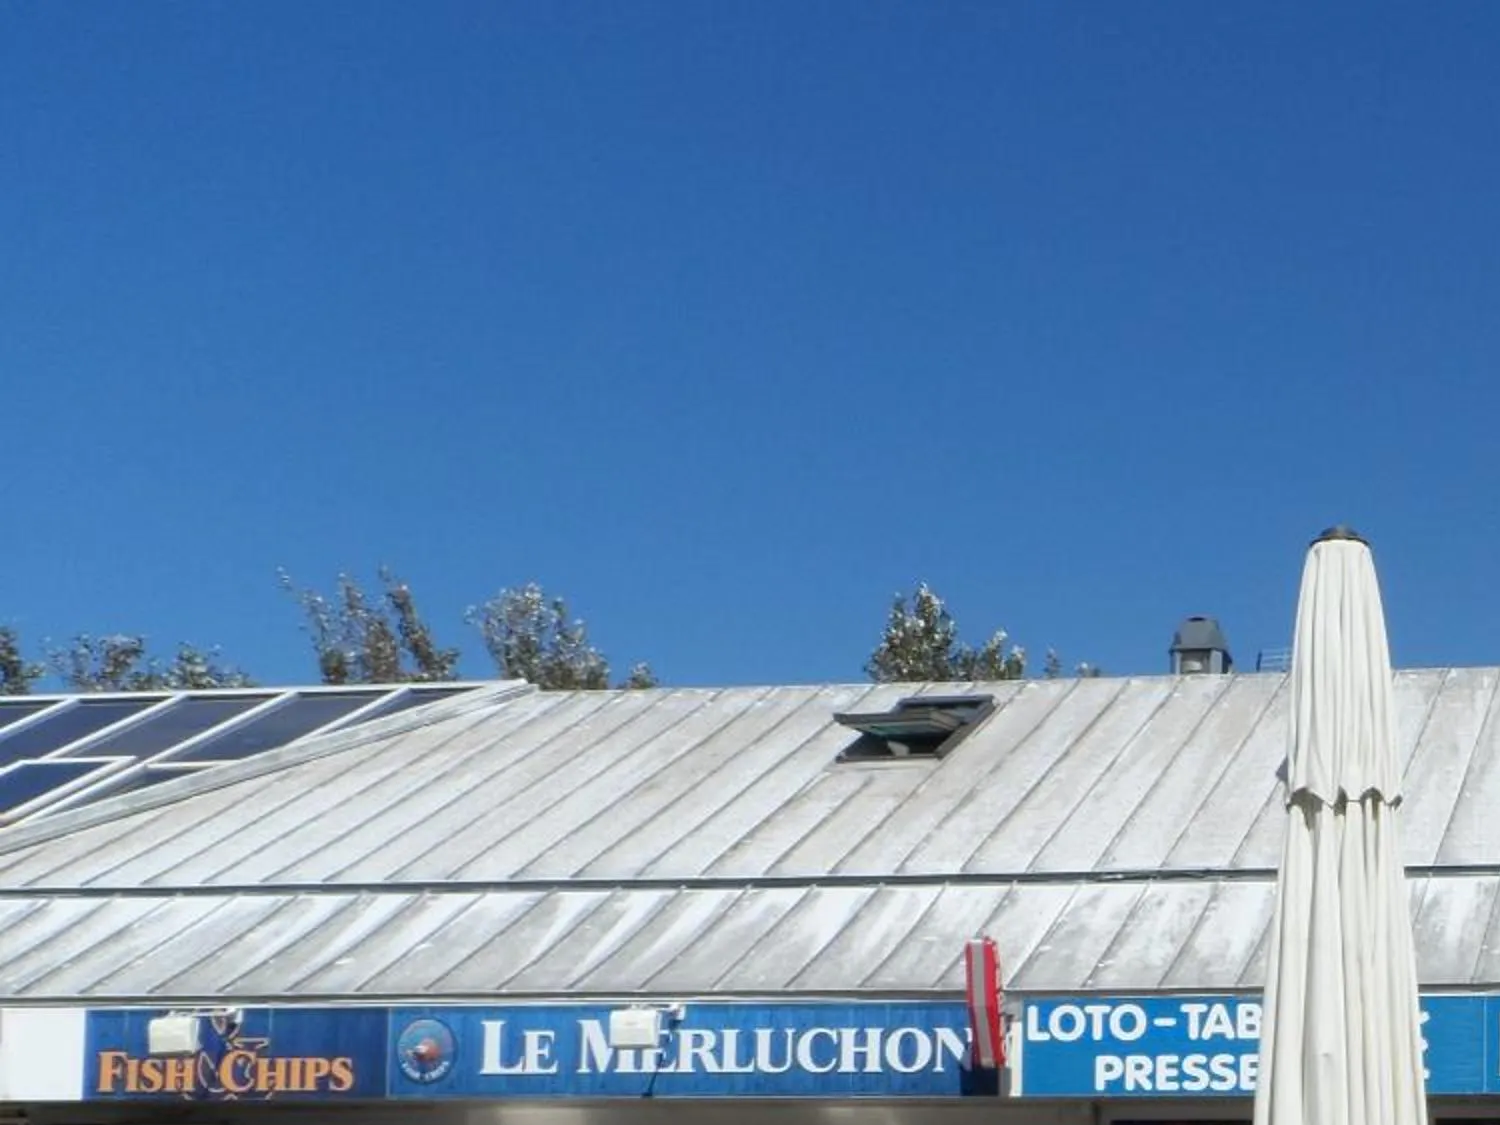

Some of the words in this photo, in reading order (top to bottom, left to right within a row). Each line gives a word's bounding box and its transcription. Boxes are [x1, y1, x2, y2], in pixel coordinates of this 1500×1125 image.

[1026, 1003, 1262, 1042] LOTO-TAB
[480, 1019, 558, 1074] LE
[576, 1019, 973, 1074] MERLUCHON
[98, 1049, 197, 1092] FISH
[218, 1048, 356, 1092] CHIPS
[1094, 1053, 1259, 1091] PRESSE
